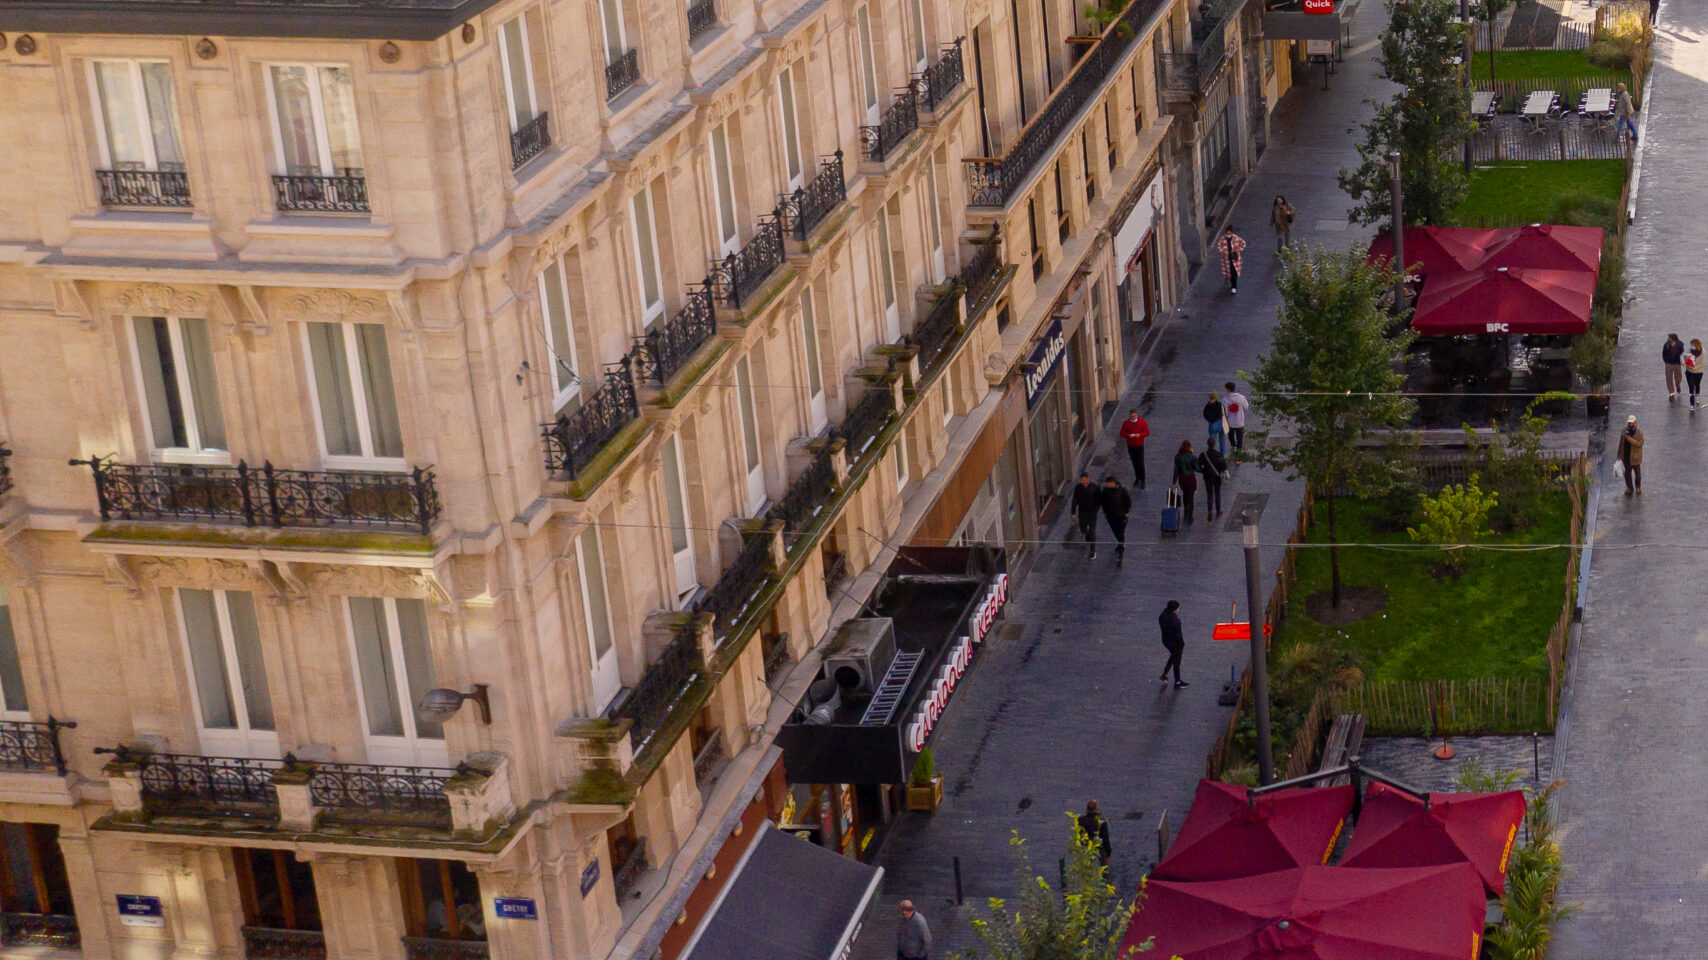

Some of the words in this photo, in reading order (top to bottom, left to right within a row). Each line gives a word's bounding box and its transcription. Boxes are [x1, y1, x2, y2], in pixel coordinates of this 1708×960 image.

[1305, 0, 1331, 8] Quick
[1486, 323, 1509, 333] BFC
[1026, 331, 1065, 399] Leonidas
[910, 636, 974, 752] CAPADOCIA
